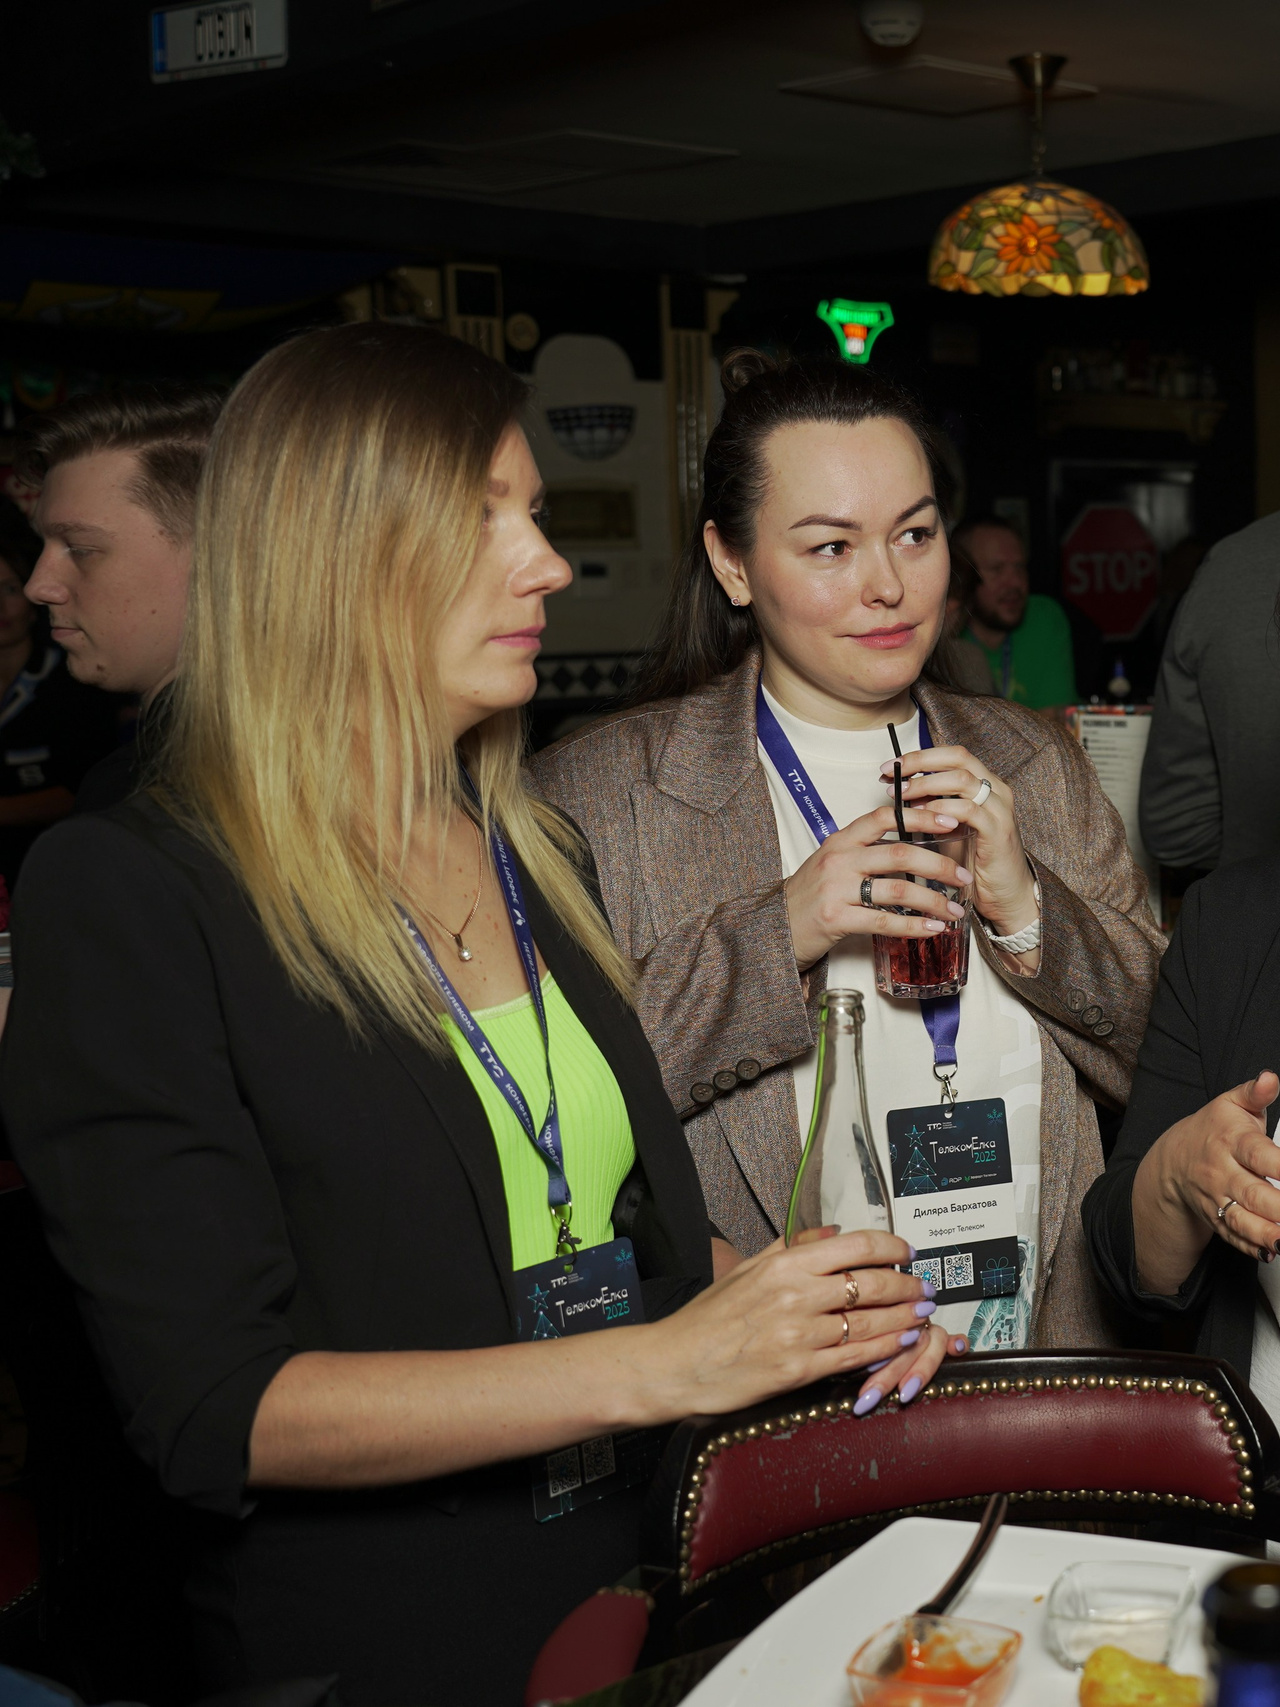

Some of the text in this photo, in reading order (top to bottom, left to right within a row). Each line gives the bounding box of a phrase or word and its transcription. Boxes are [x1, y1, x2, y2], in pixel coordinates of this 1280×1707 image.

[1067, 551, 1153, 595] STOP
[788, 768, 831, 838] ТТС КОНФЕРЕНЦИ
[503, 865, 520, 905] ЭФФОРТ
[442, 983, 475, 1033] ТЕЛЕКОМ
[480, 1041, 504, 1078] ТТС
[974, 1150, 997, 1164] 2025
[913, 1199, 998, 1219] Диляра Бархатова
[928, 1223, 985, 1237] Эффорт Телеком
[605, 1300, 631, 1321] 2025
